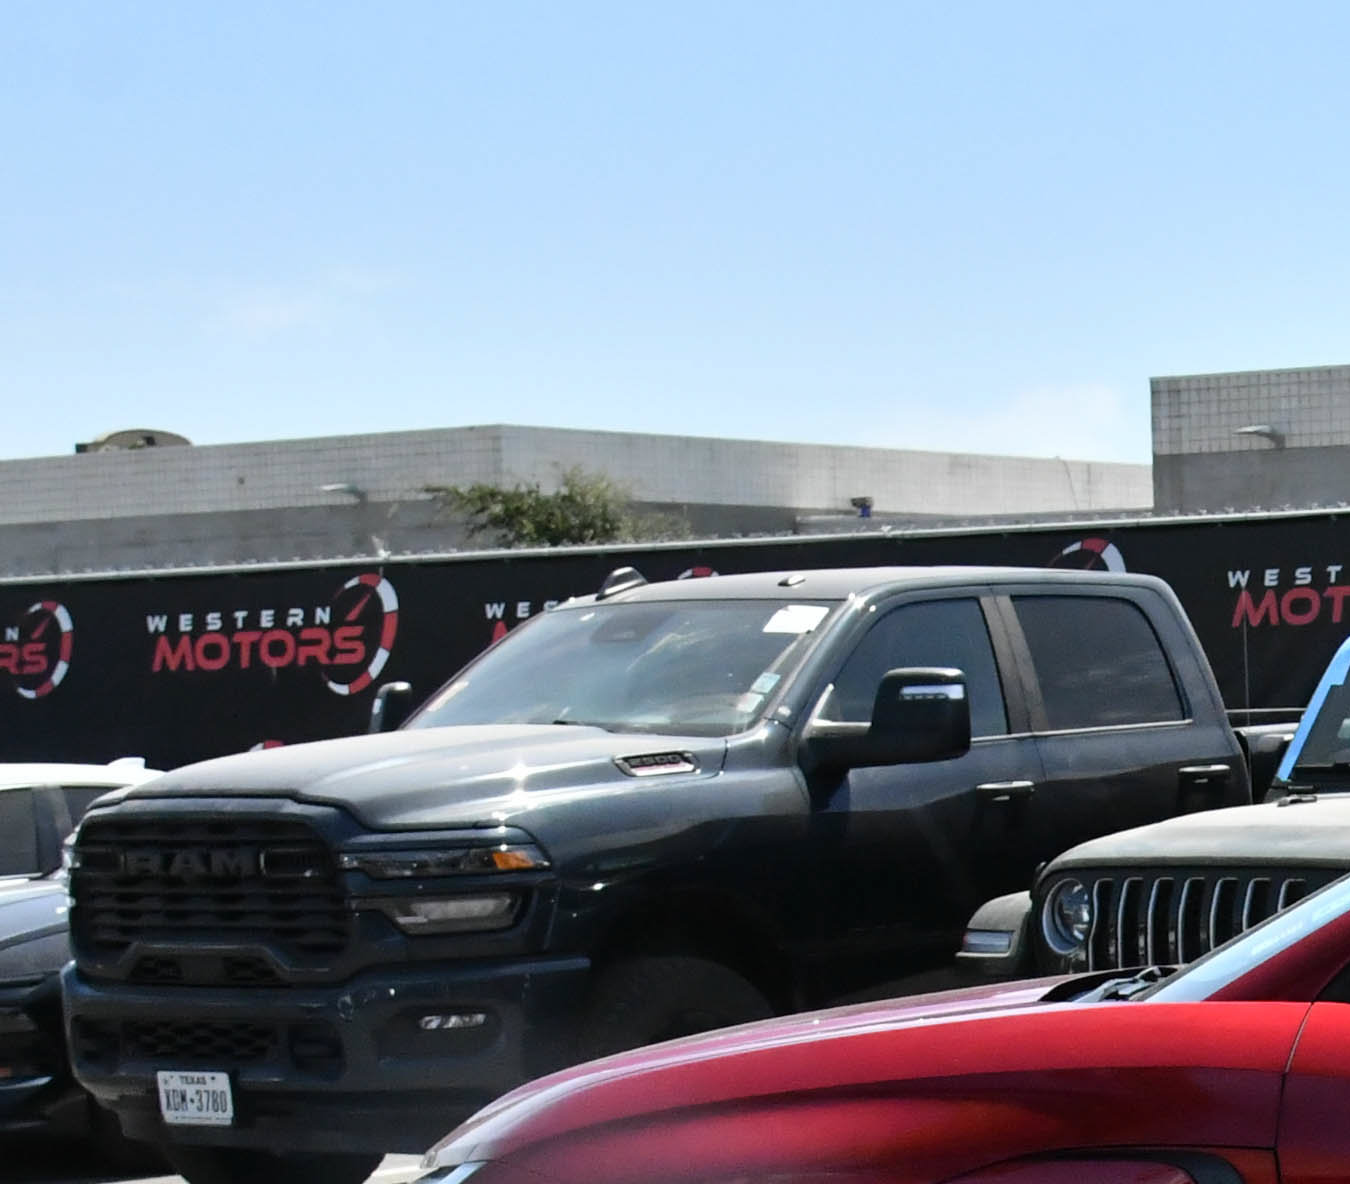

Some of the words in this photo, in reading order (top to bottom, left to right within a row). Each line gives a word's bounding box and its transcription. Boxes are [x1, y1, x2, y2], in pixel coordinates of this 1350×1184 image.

[146, 606, 331, 633] WESTERN
[152, 626, 366, 673] MOTORS
[125, 850, 256, 875] RAM
